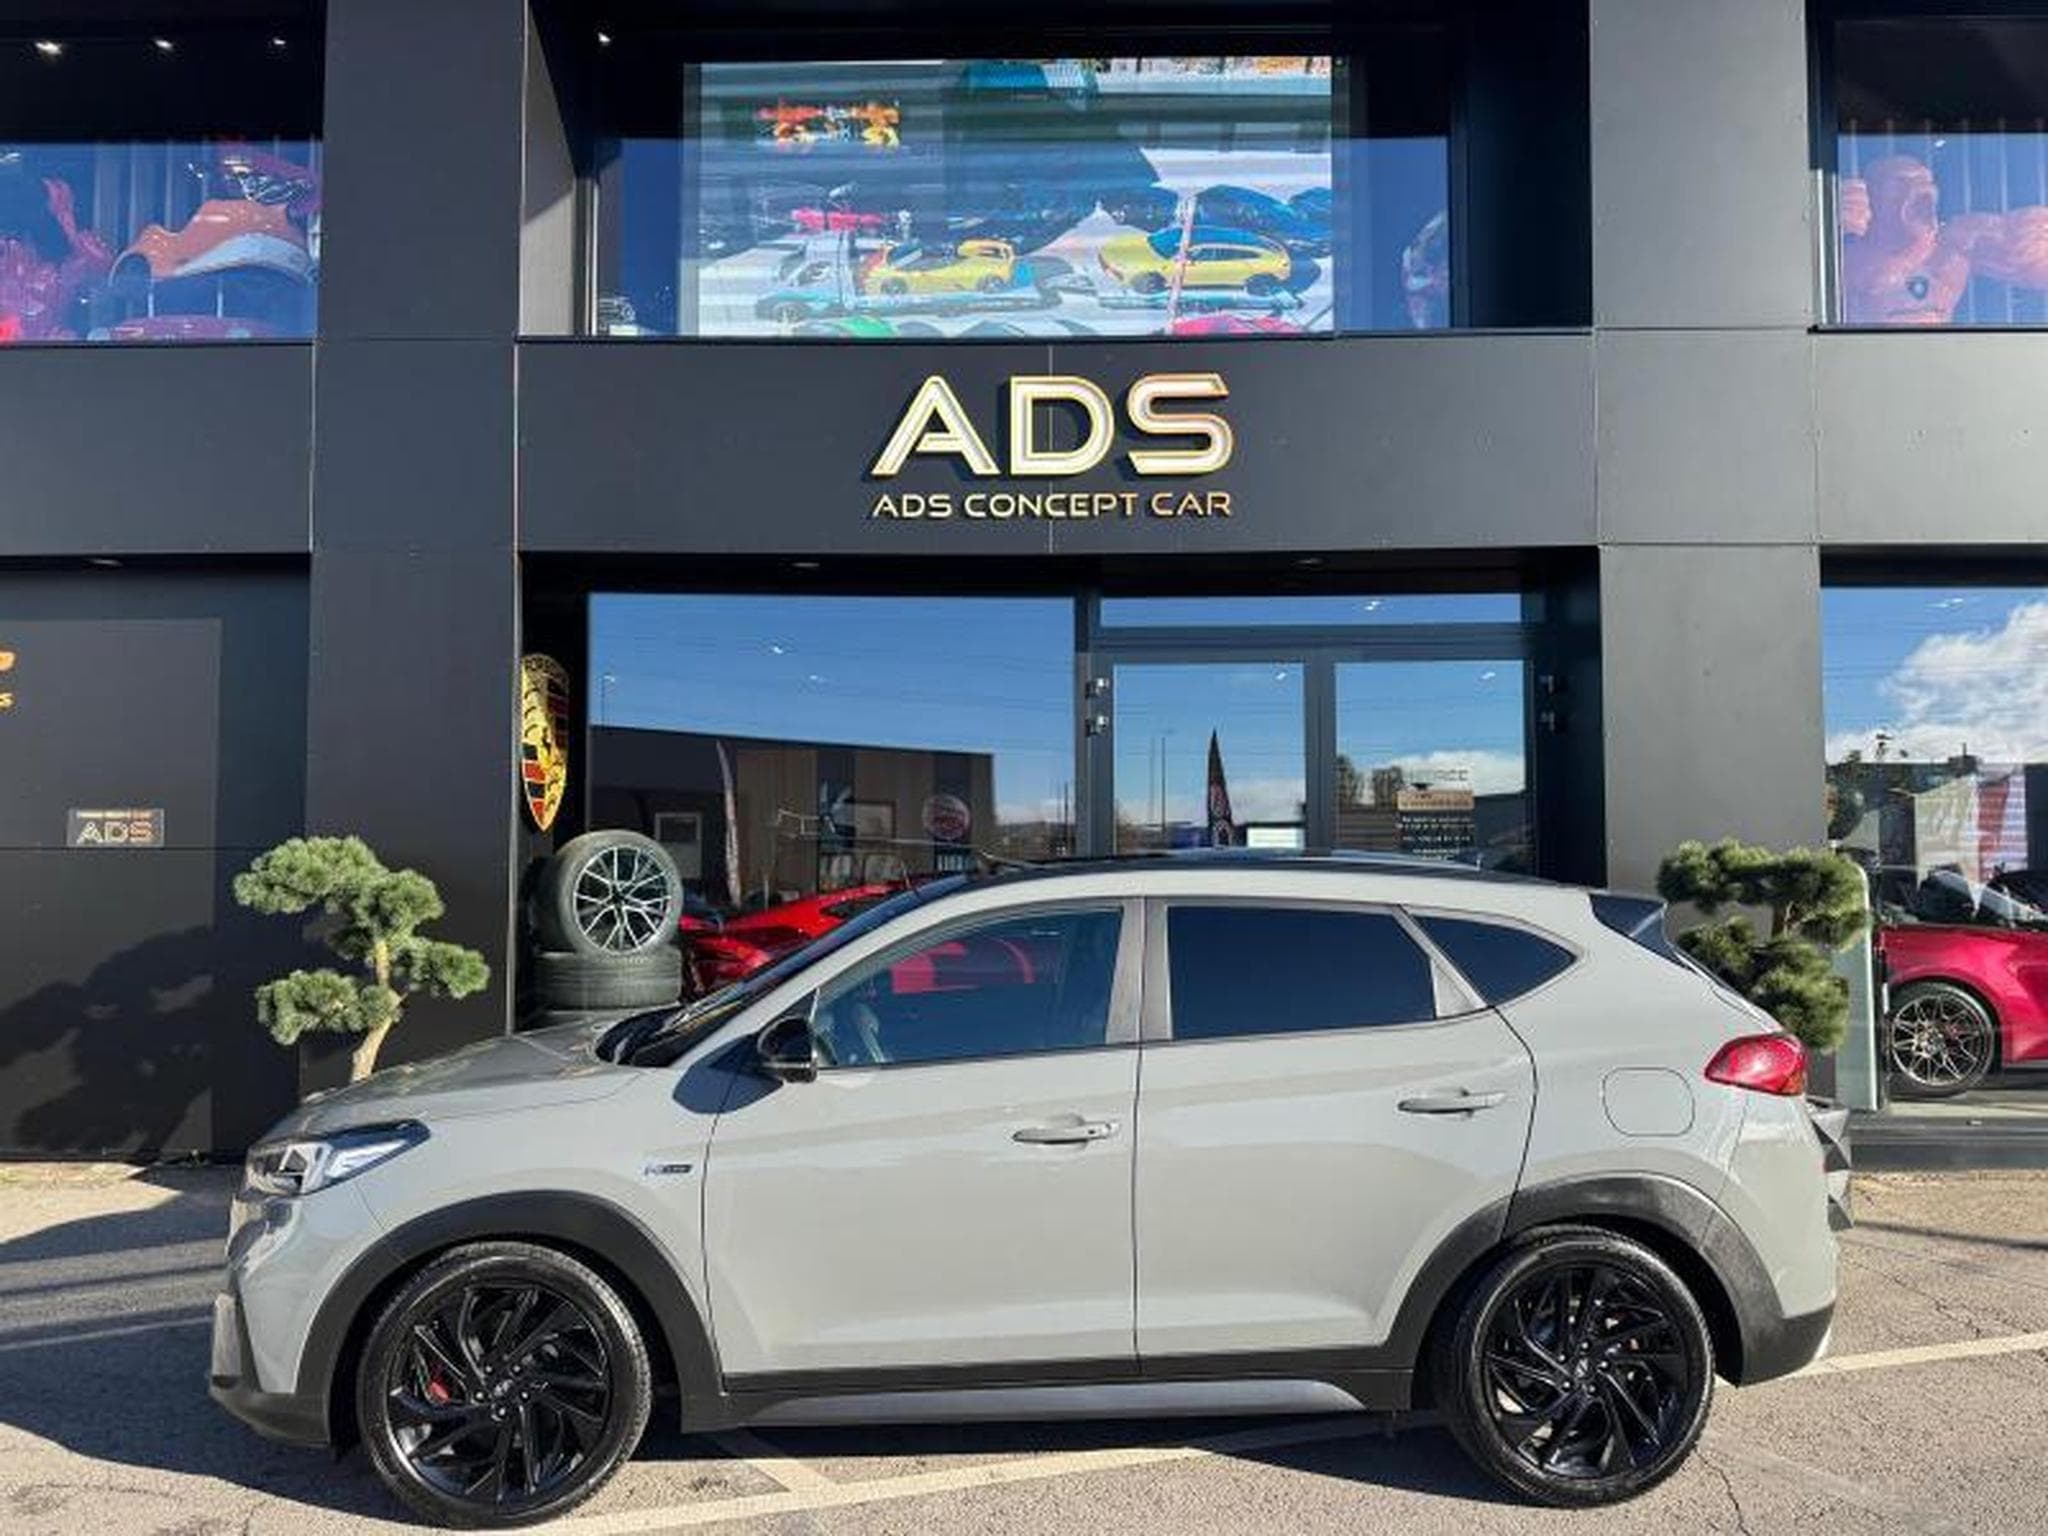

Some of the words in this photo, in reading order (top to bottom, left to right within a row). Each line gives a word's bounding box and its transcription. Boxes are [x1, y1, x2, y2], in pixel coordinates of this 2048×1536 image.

[871, 373, 1234, 476] ADS
[872, 494, 952, 518] ADS
[964, 493, 1139, 518] CONCEPT
[1151, 491, 1232, 517] CAR
[76, 821, 153, 844] ADS
